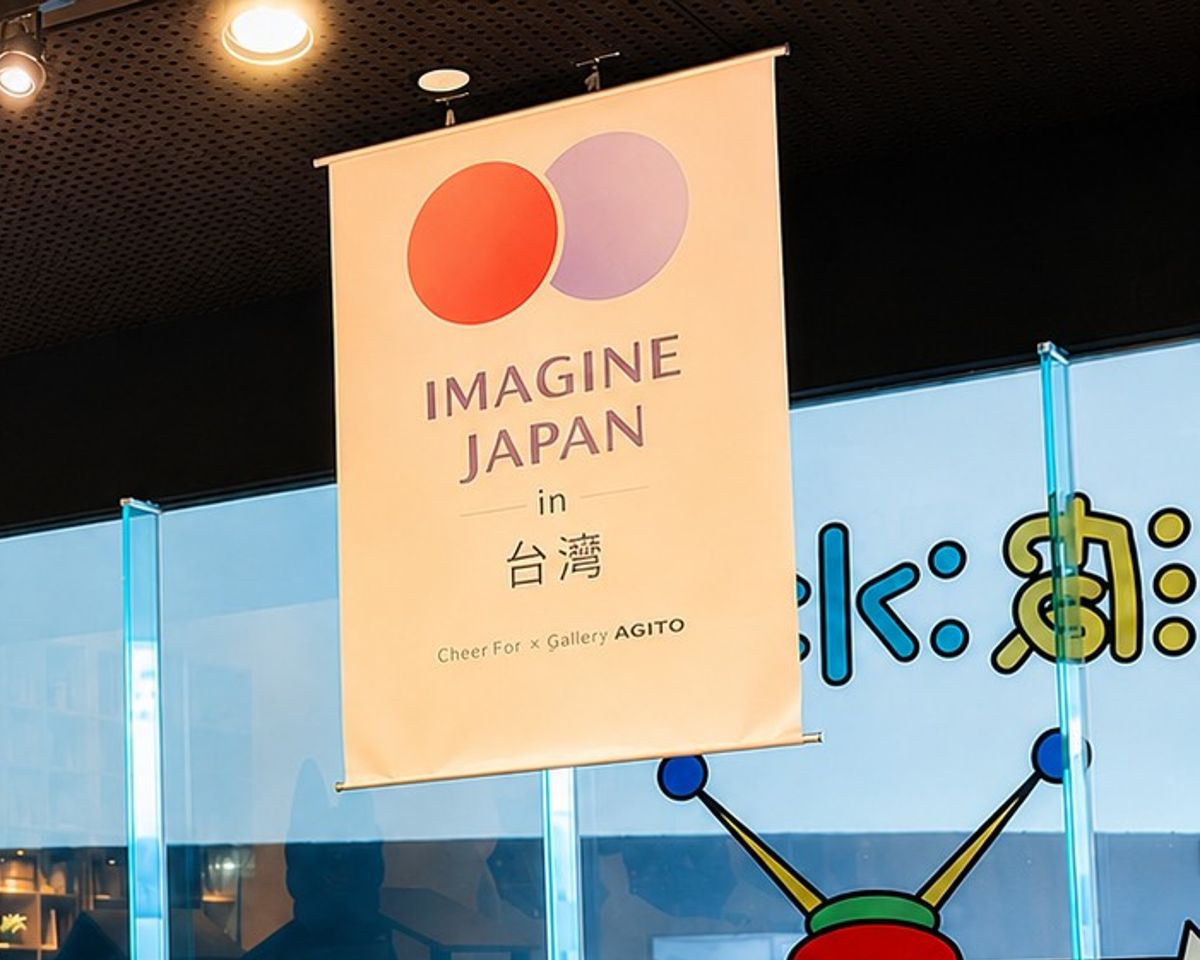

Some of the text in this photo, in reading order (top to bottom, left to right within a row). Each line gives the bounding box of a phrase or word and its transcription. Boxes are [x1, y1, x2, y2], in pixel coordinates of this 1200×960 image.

[426, 334, 681, 420] IMAGINE
[459, 405, 644, 484] JAPAN
[538, 489, 566, 515] in
[437, 644, 489, 664] Cheer
[492, 640, 521, 656] For
[547, 630, 609, 652] Gallery
[614, 618, 685, 640] AGITO
